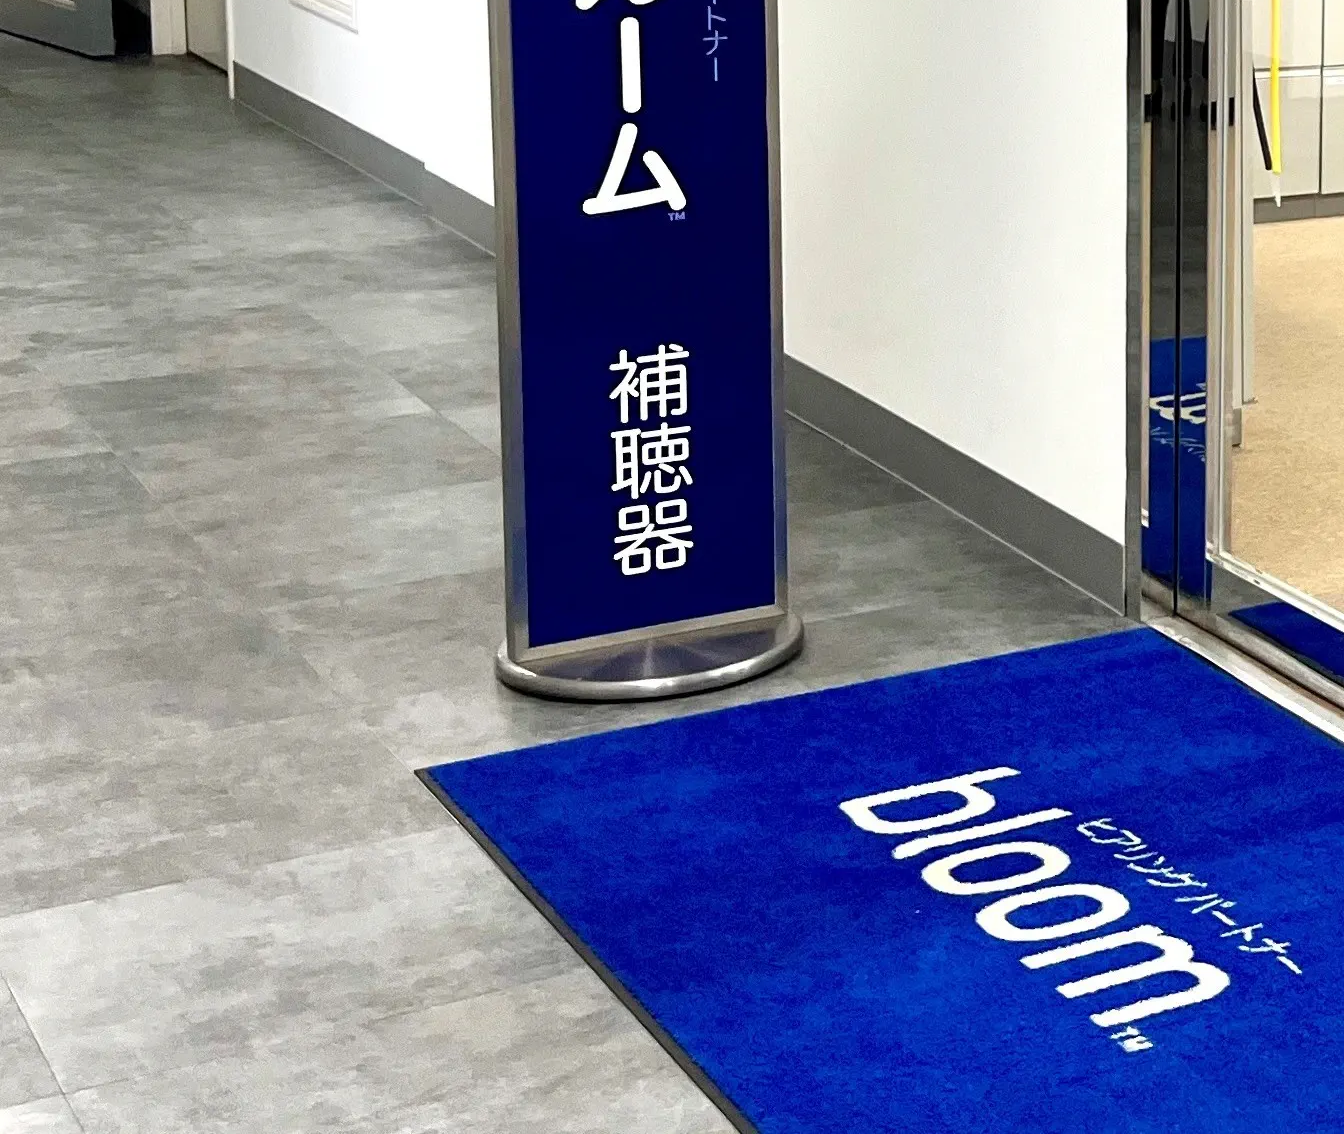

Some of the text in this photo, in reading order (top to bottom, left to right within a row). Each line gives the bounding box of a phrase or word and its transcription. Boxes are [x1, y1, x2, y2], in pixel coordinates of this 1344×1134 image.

[609, 343, 694, 576] 補聴器
[839, 766, 1231, 1027] bloom
[1076, 818, 1303, 975] ヒアリング パートナー
